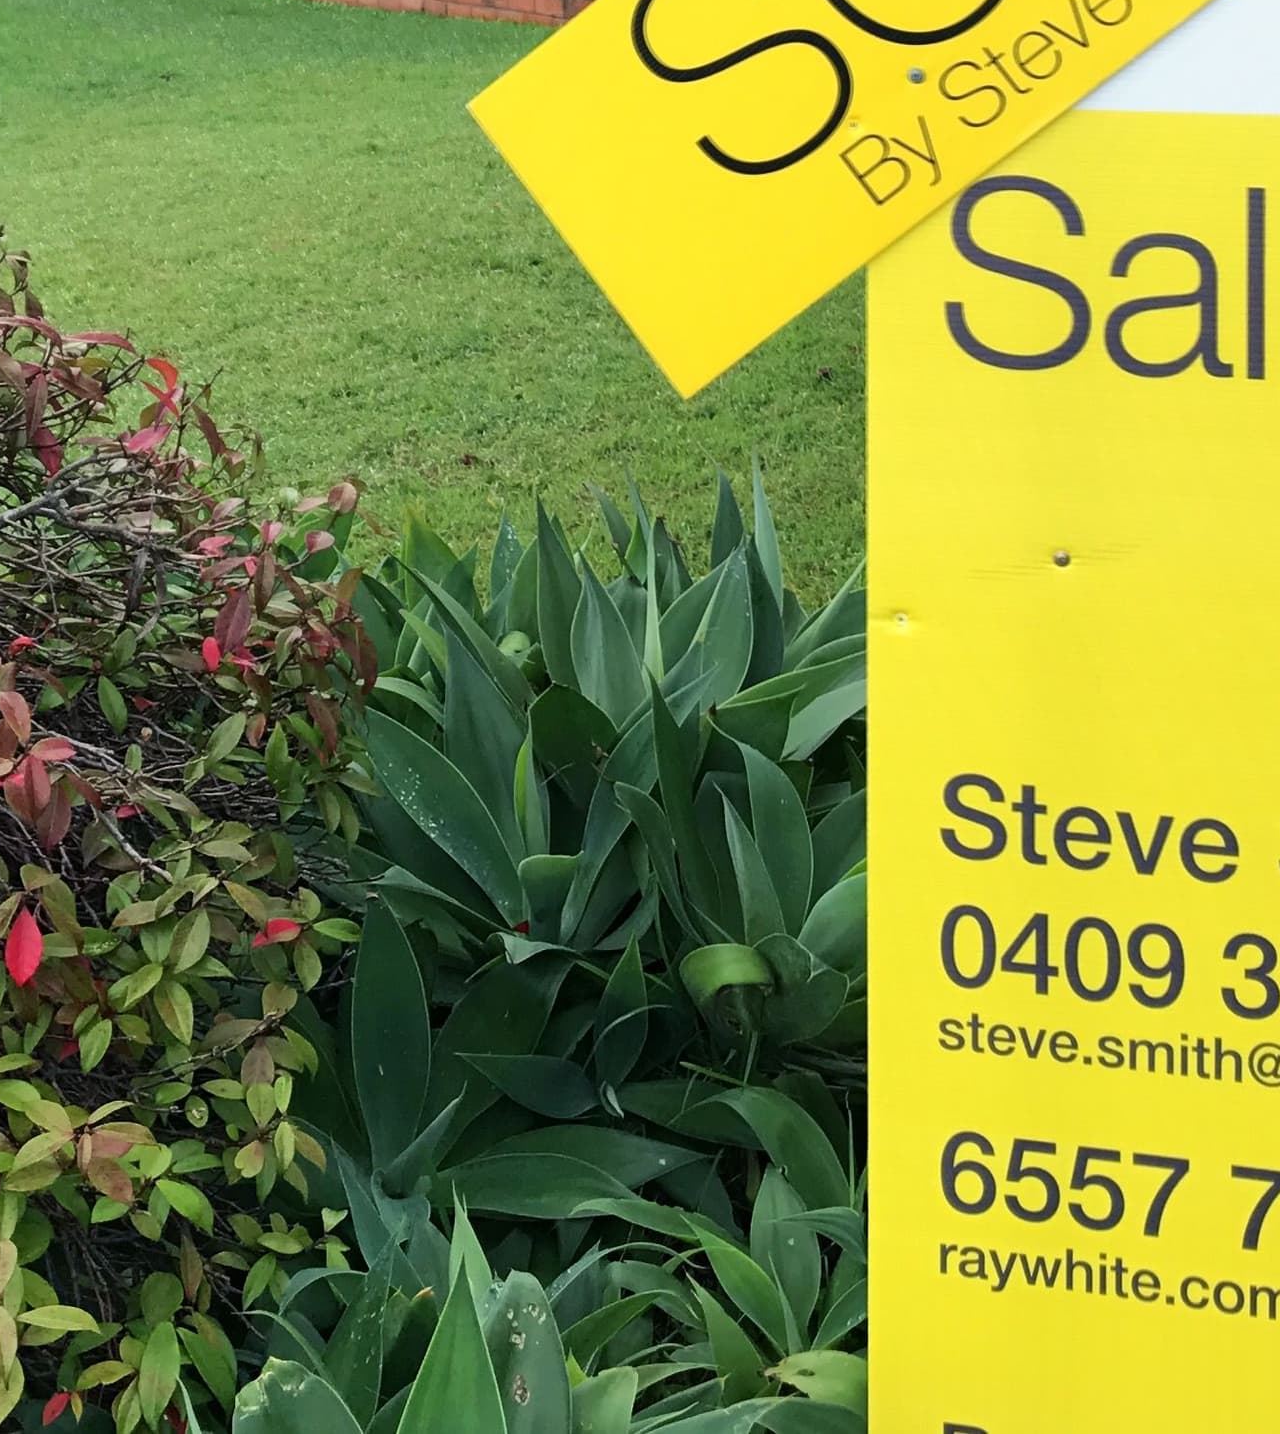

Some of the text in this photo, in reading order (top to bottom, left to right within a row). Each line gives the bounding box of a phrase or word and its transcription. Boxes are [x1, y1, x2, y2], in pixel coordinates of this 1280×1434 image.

[839, 115, 942, 207] By
[939, 773, 1240, 884] Steve
[939, 904, 1185, 1009] 0409
[939, 1131, 1190, 1237] 6557
